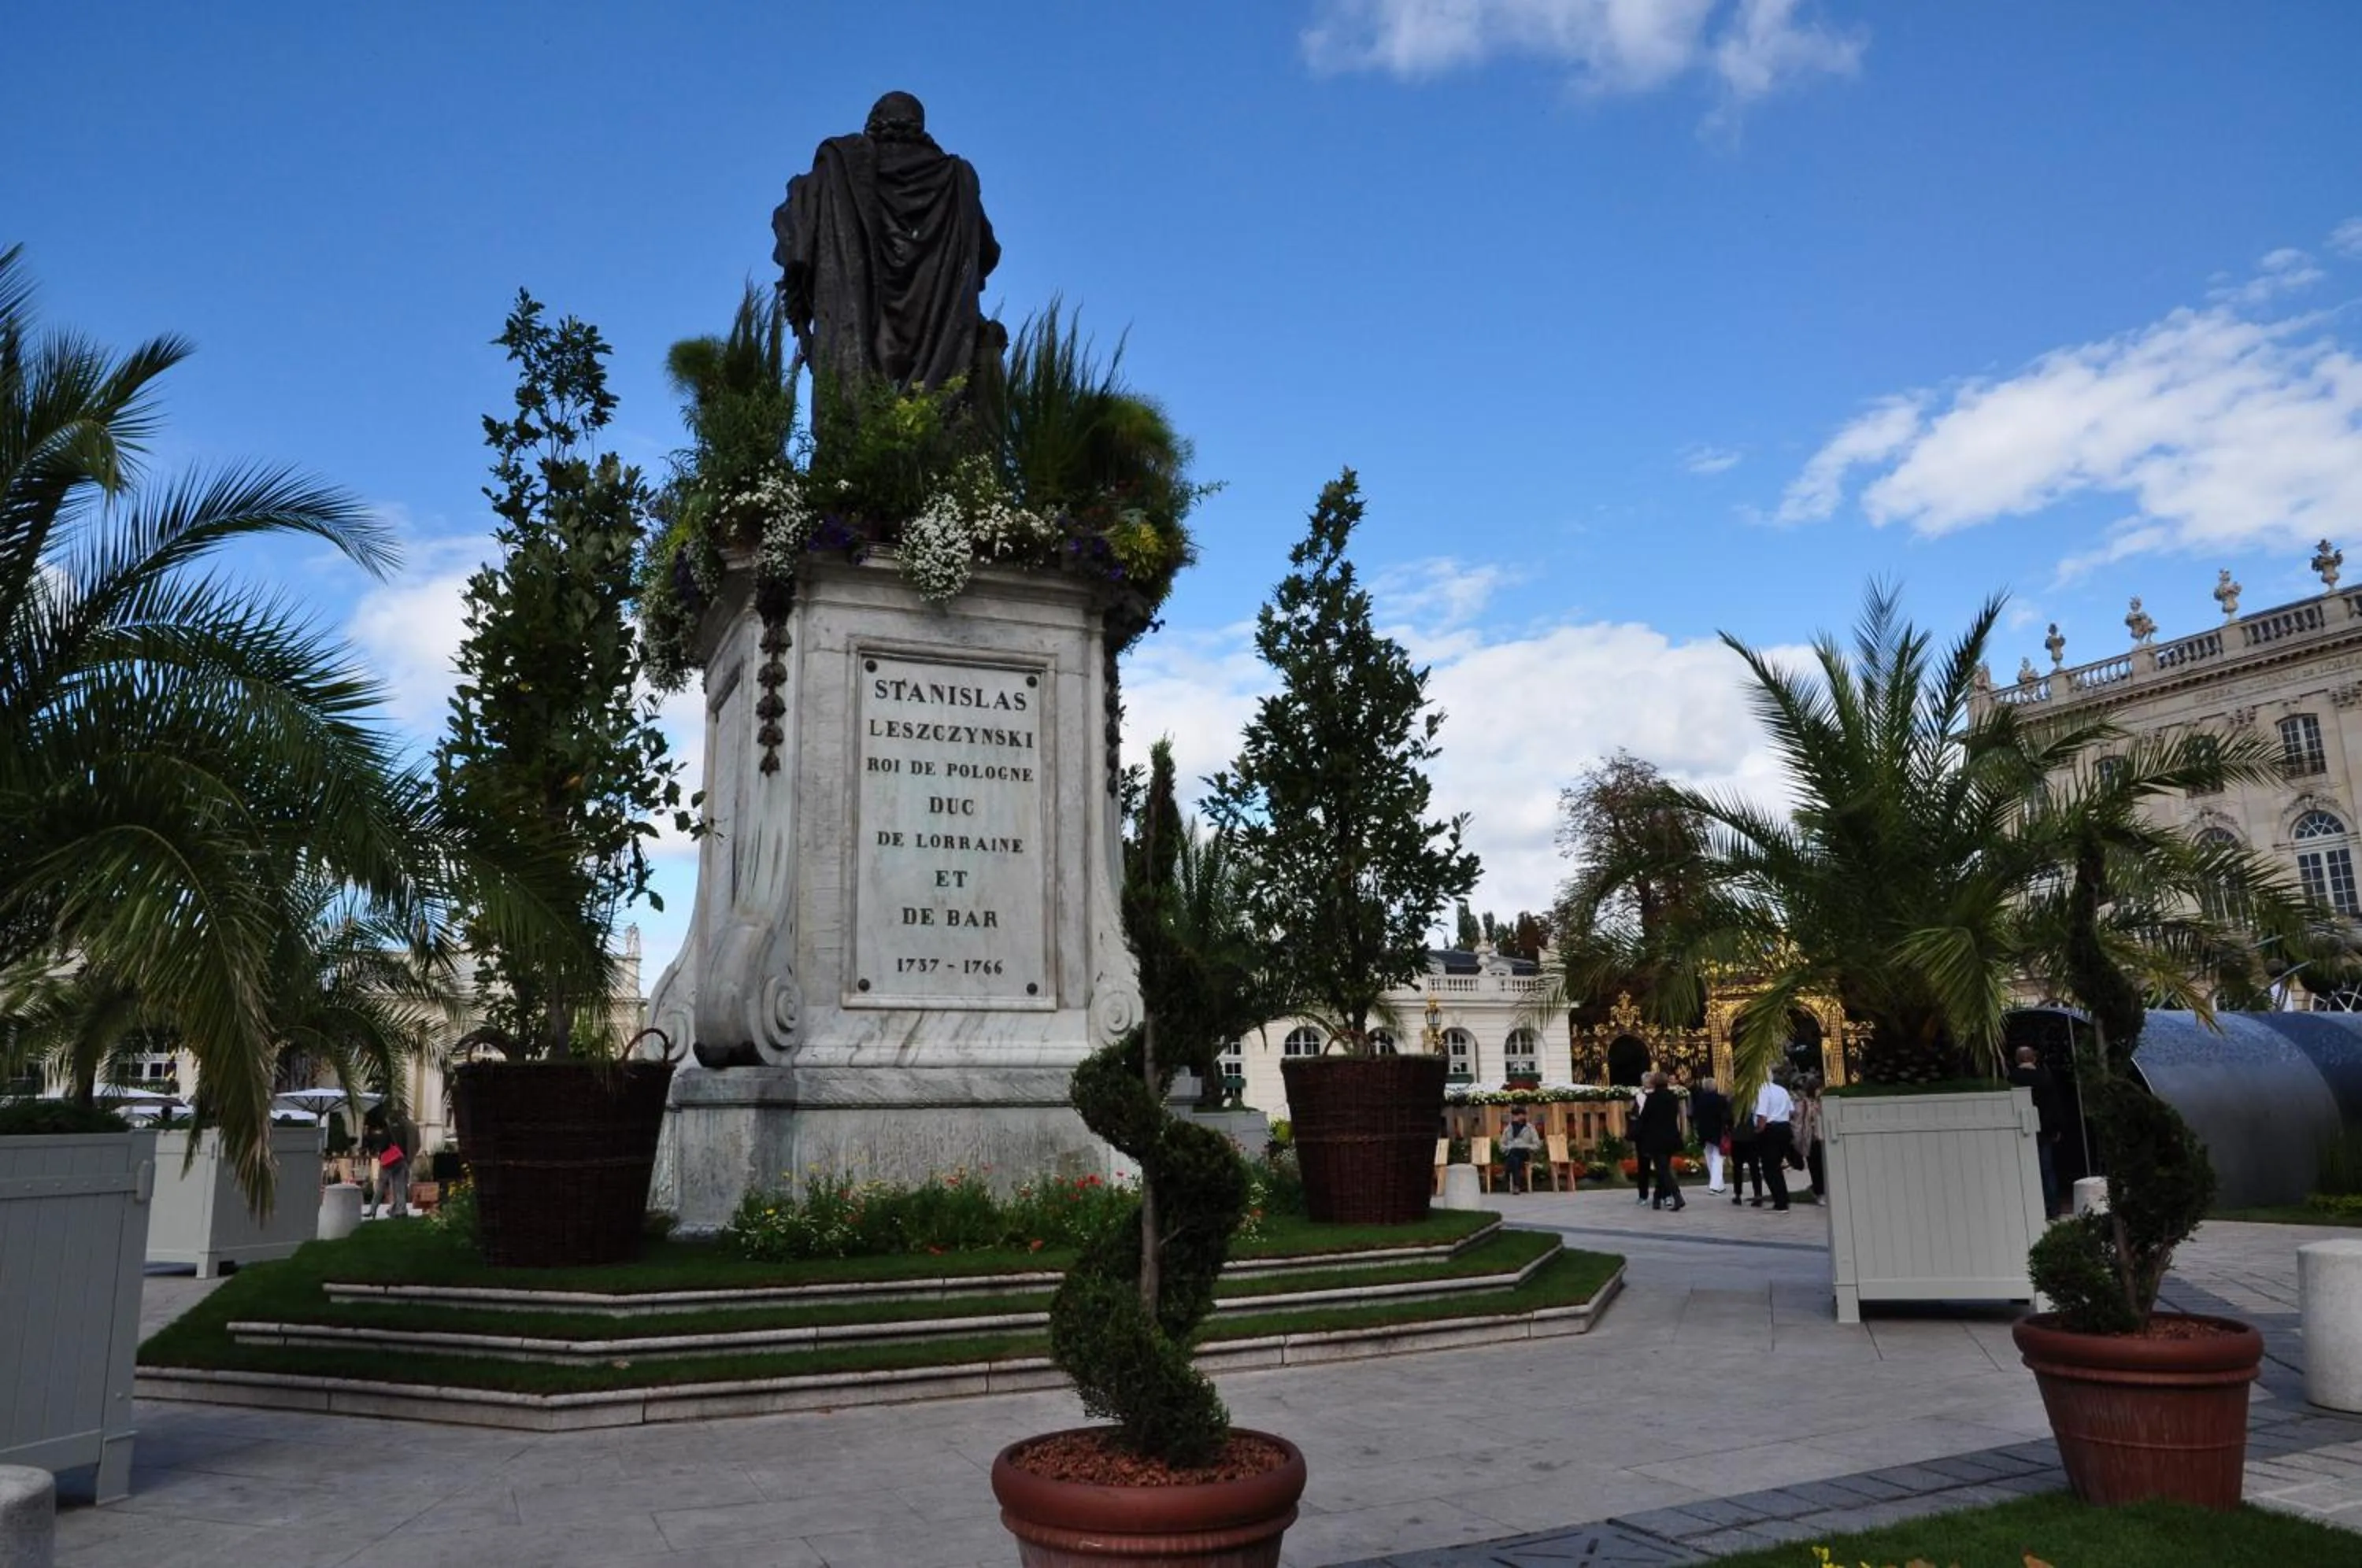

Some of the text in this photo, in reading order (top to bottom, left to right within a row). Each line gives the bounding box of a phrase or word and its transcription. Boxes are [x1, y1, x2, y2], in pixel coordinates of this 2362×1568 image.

[875, 679, 1027, 711] STANISLAS
[869, 719, 1034, 748] LESZCZYNSKI
[867, 757, 1034, 782] ROI DE POLOGNE
[929, 796, 975, 815] DUC
[877, 831, 1024, 853] DE LORRAINE
[935, 870, 968, 887] ET
[902, 907, 998, 928] DE BAR
[897, 958, 939, 973] 1737
[964, 959, 1003, 974] 1766
